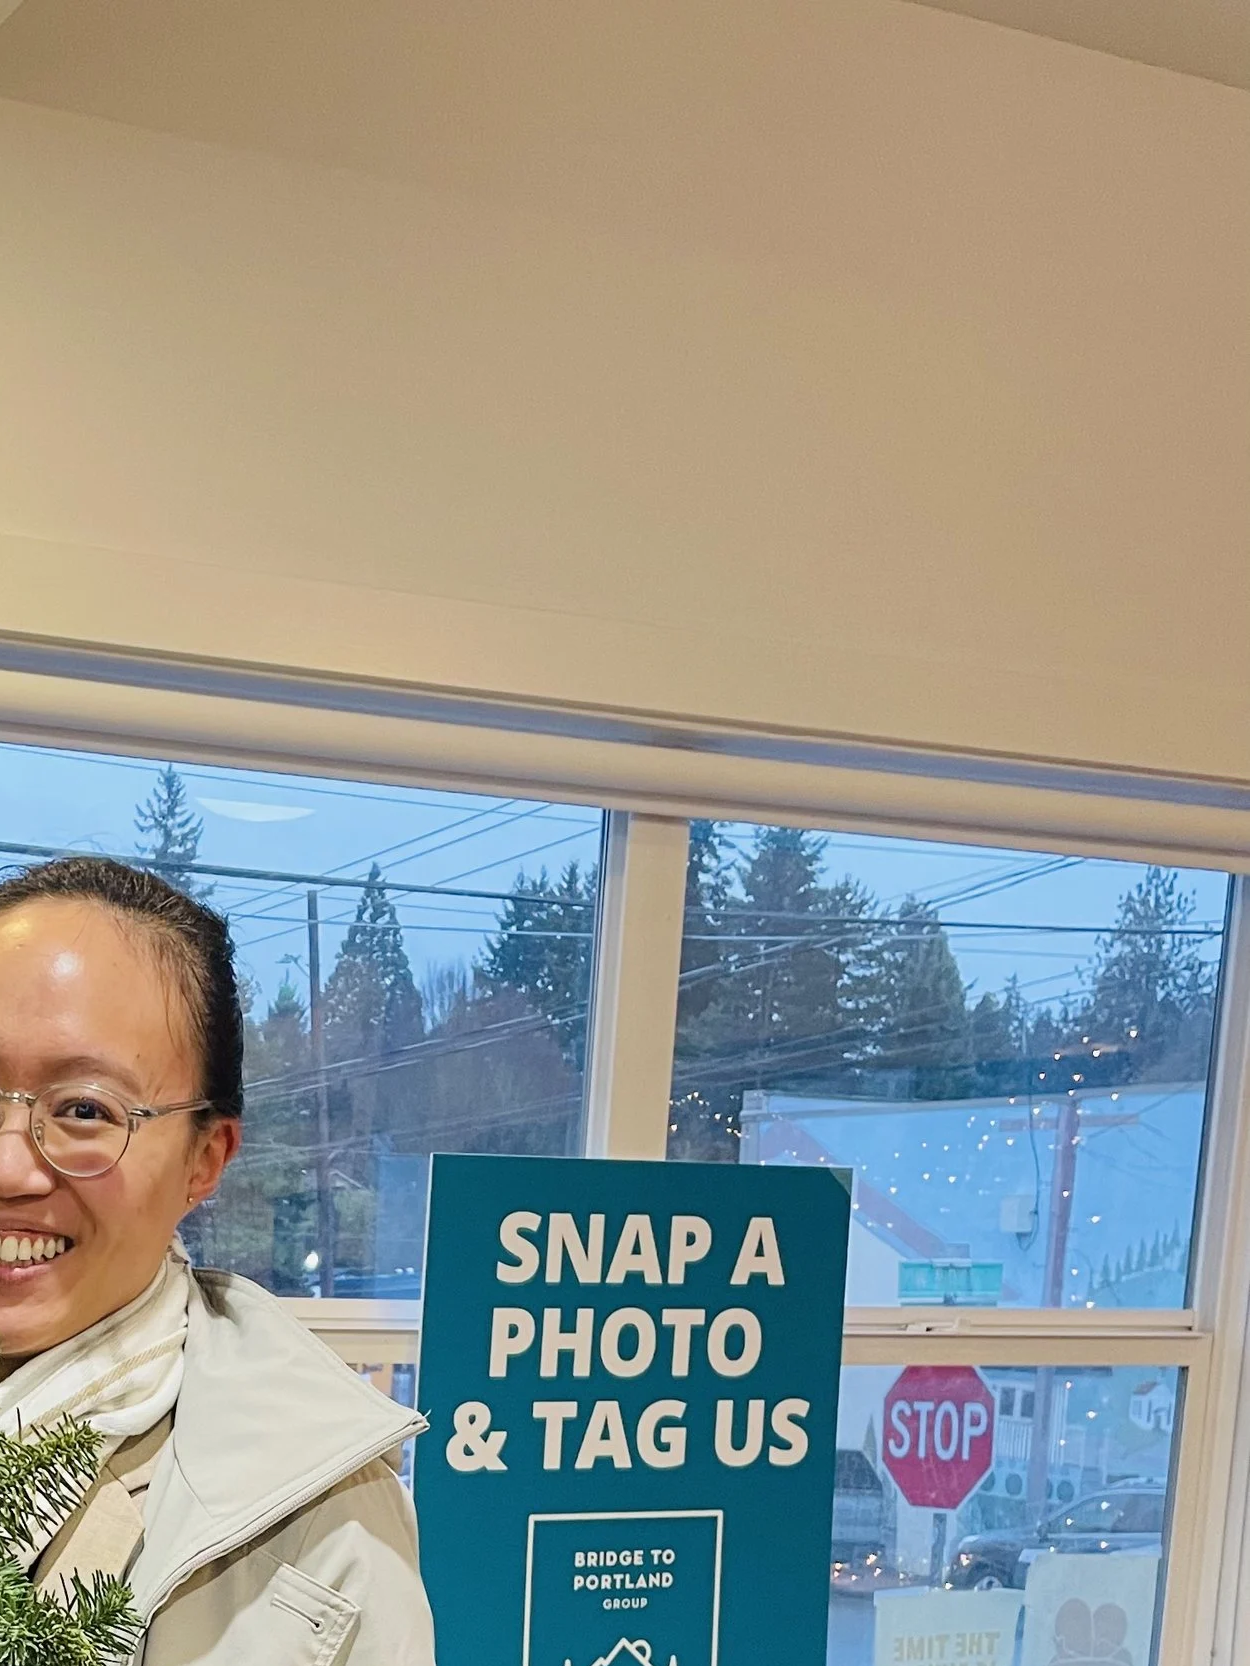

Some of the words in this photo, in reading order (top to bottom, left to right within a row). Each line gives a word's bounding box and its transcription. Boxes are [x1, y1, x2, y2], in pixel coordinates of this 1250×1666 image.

[496, 1211, 713, 1285] SNAP
[730, 1217, 785, 1286] A
[488, 1307, 763, 1378] PHOTO
[445, 1401, 508, 1472] &
[532, 1400, 688, 1471] TAG
[714, 1398, 811, 1467] US
[888, 1400, 988, 1461] STOP
[573, 1572, 674, 1591] PORTLAND
[574, 1550, 644, 1568] BRIDGE
[650, 1549, 676, 1565] TO
[602, 1597, 648, 1610] GROUP
